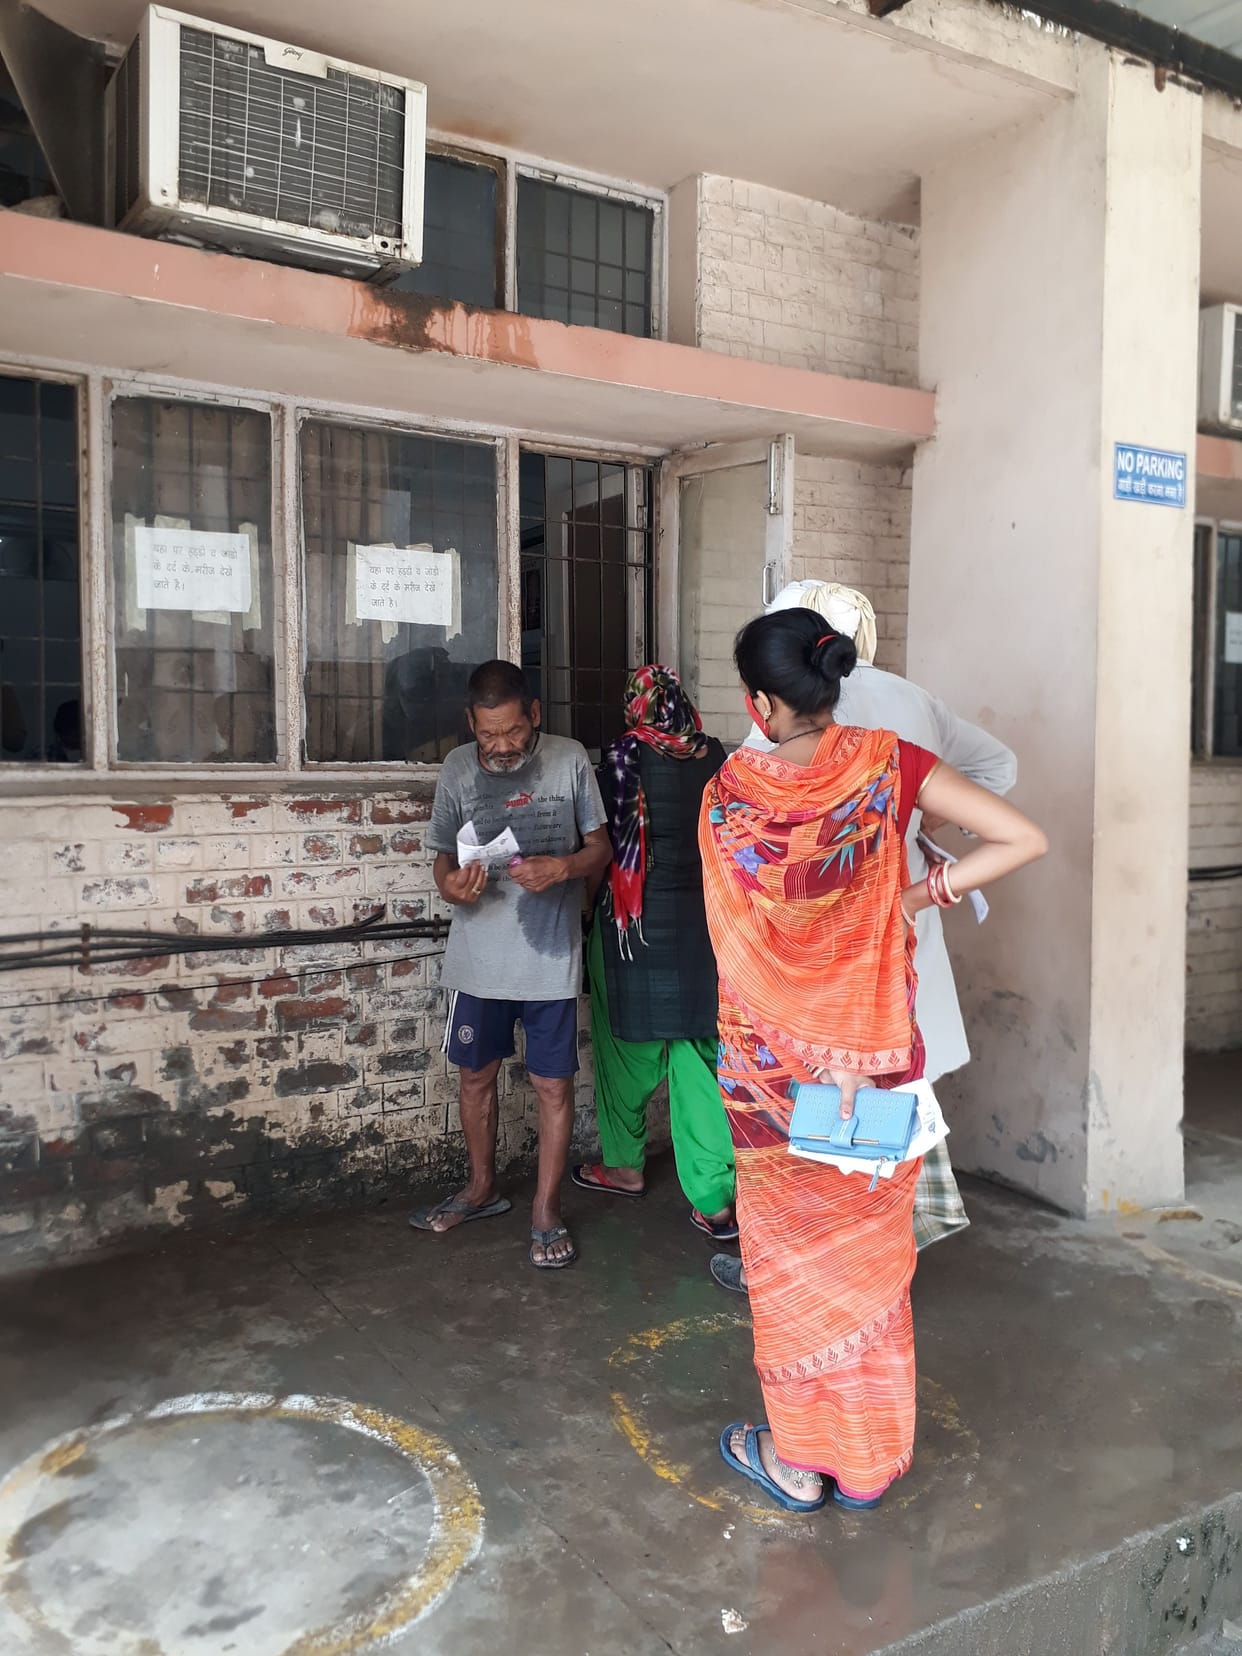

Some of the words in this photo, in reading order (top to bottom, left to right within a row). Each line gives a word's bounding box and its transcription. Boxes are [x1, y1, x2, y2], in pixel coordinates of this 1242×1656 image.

[1117, 450, 1135, 473] NO
[1135, 453, 1184, 481] PARKING
[172, 544, 184, 555] पर
[152, 559, 161, 570] के
[166, 560, 177, 573] दर्द
[181, 561, 191, 573] के
[192, 563, 216, 575] मरीज
[385, 566, 395, 576] पर
[152, 577, 169, 590] जाते
[369, 579, 377, 591] के
[380, 580, 390, 593] दर्द
[393, 579, 401, 591] के
[403, 580, 421, 593] मरीज
[424, 580, 436, 593] देखे
[371, 596, 385, 608] जाते
[537, 795, 548, 803] the
[548, 794, 565, 803] thing
